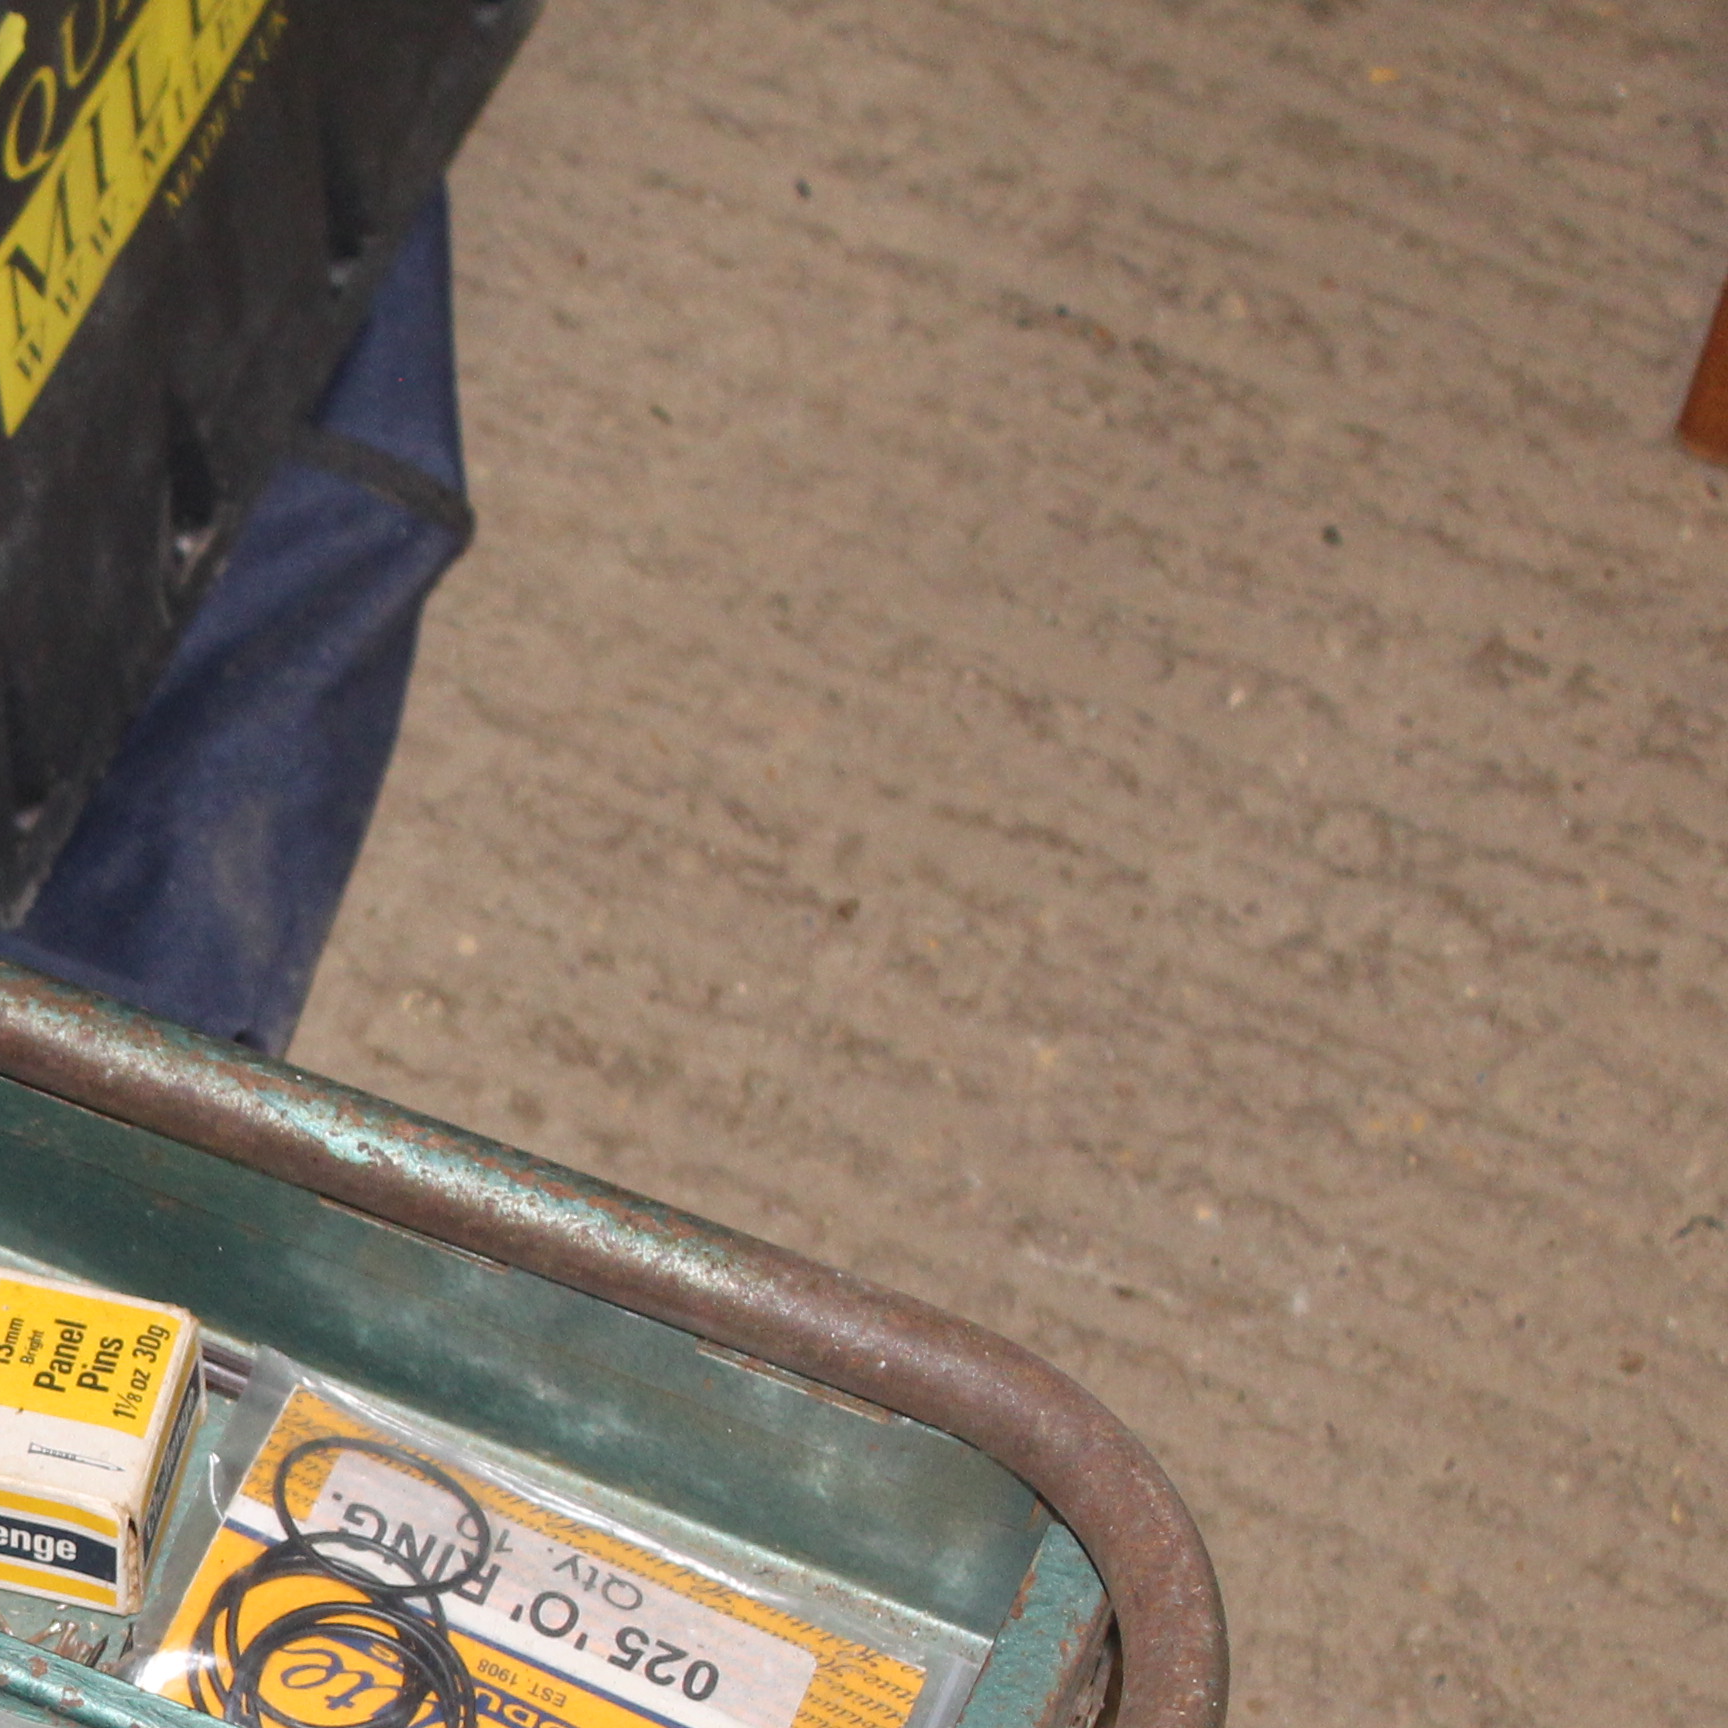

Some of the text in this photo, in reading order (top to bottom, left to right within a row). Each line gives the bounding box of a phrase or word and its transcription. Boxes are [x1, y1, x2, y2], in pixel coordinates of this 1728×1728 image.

[20, 1329, 45, 1365] Bright
[33, 1318, 88, 1393] Panel
[76, 1336, 124, 1393] Pins
[132, 1323, 171, 1364] 30g
[130, 1368, 151, 1391] oz
[548, 1547, 644, 1611] Qty.
[477, 1658, 568, 1708] EST. 1908
[607, 1626, 720, 1702] 025
